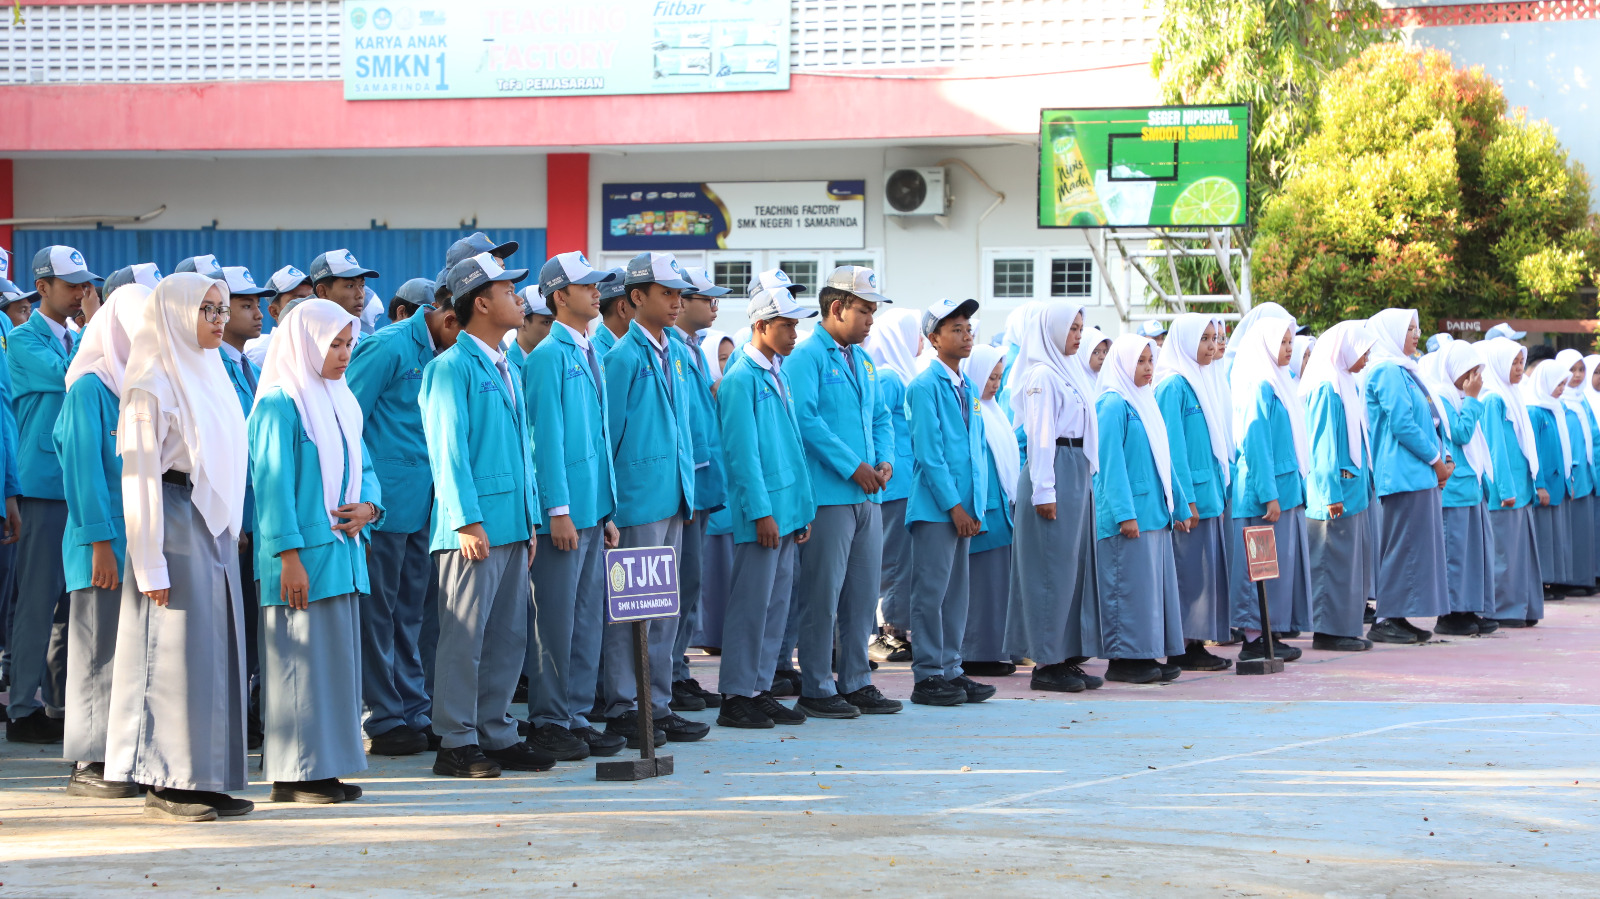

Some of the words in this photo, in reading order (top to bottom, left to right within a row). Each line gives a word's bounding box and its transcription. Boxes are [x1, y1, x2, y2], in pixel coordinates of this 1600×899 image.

[652, 0, 706, 17] Fitbar
[482, 6, 626, 35] TEACHING
[355, 36, 402, 49] KARYA
[408, 35, 447, 48] ANAK
[487, 41, 617, 71] FACTORY
[355, 54, 430, 78] SMKN
[435, 52, 449, 91] 1
[355, 83, 430, 92] SAMARINDA
[497, 79, 523, 90] TeFa
[526, 77, 604, 90] PEMASARAN
[1147, 110, 1180, 125] SEGER
[1182, 109, 1233, 125] NIPISNYA,
[1141, 126, 1185, 141] SMOOTH
[1187, 125, 1239, 140] SODANYA!
[1057, 159, 1083, 182] Nipis
[1057, 172, 1091, 202] Madu
[754, 205, 799, 216] TEACHING
[802, 204, 840, 215] FACTORY
[737, 219, 757, 229] SMK
[760, 218, 793, 228] NEGERI
[796, 218, 801, 228] 1
[804, 217, 858, 228] SAMARINDA
[1446, 320, 1481, 331] DAENG
[623, 554, 673, 588] TJKT
[618, 601, 630, 611] SMK
[631, 600, 635, 609] N
[640, 598, 672, 609] SAMARINDA
